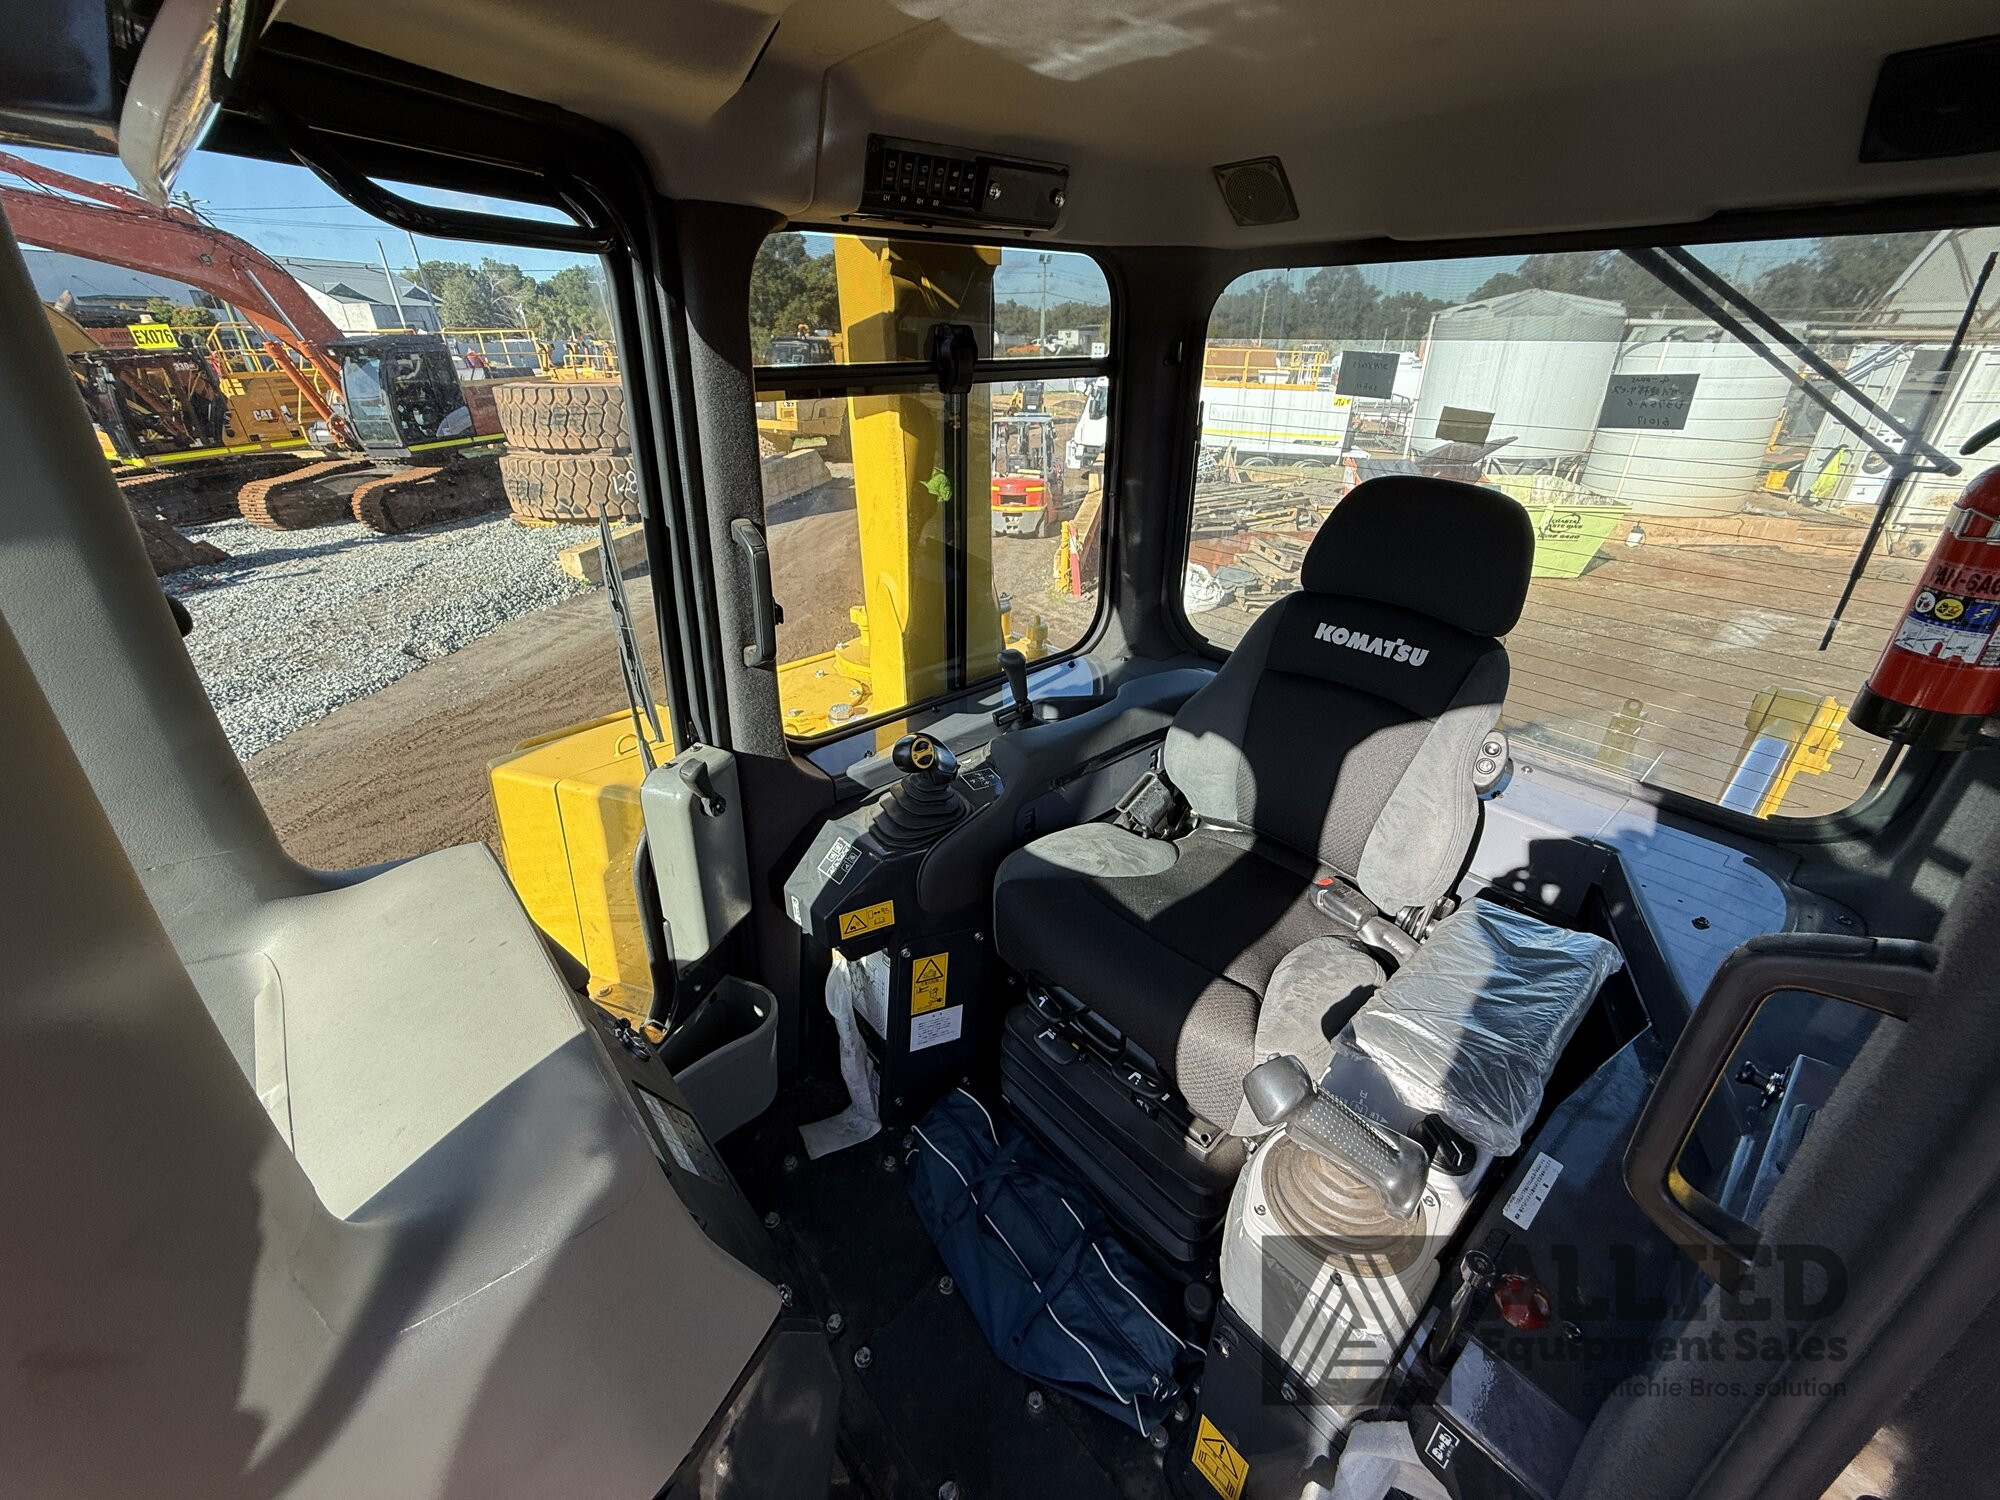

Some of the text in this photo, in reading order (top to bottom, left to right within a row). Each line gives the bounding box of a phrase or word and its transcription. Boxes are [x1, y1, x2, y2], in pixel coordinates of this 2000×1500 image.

[133, 329, 174, 345] EX076
[173, 362, 190, 371] 330
[253, 409, 273, 421] CAT
[1314, 622, 1430, 667] KOMATSU
